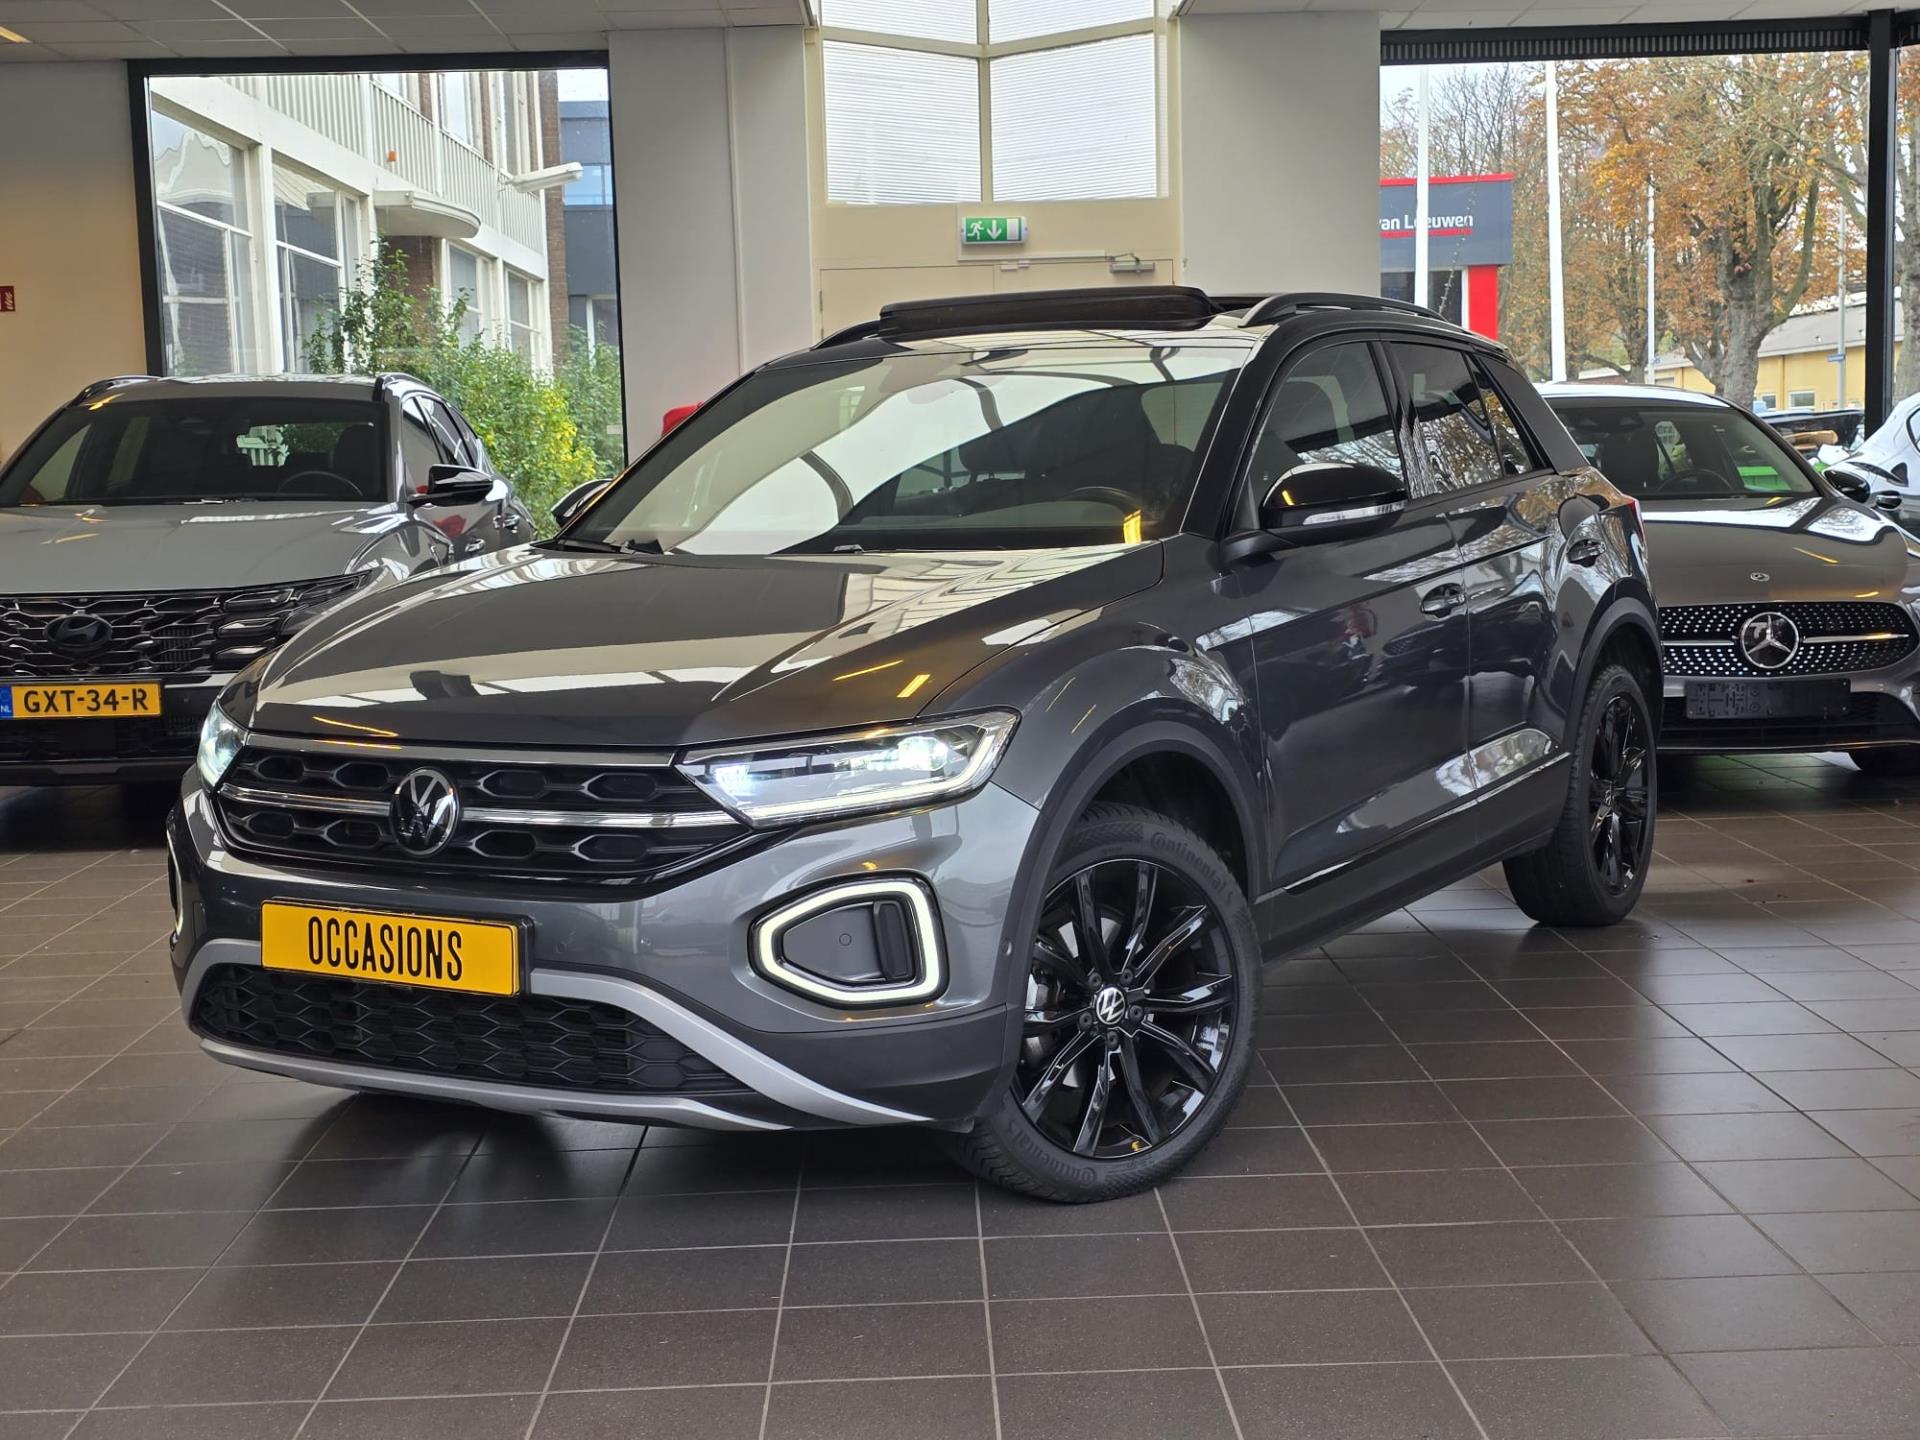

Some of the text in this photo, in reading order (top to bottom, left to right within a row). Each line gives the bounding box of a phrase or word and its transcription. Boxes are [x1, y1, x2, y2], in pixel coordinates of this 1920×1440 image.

[1379, 218, 1400, 230] an
[23, 688, 149, 713] GXT-34-R
[308, 916, 462, 981] OCCASIONS
